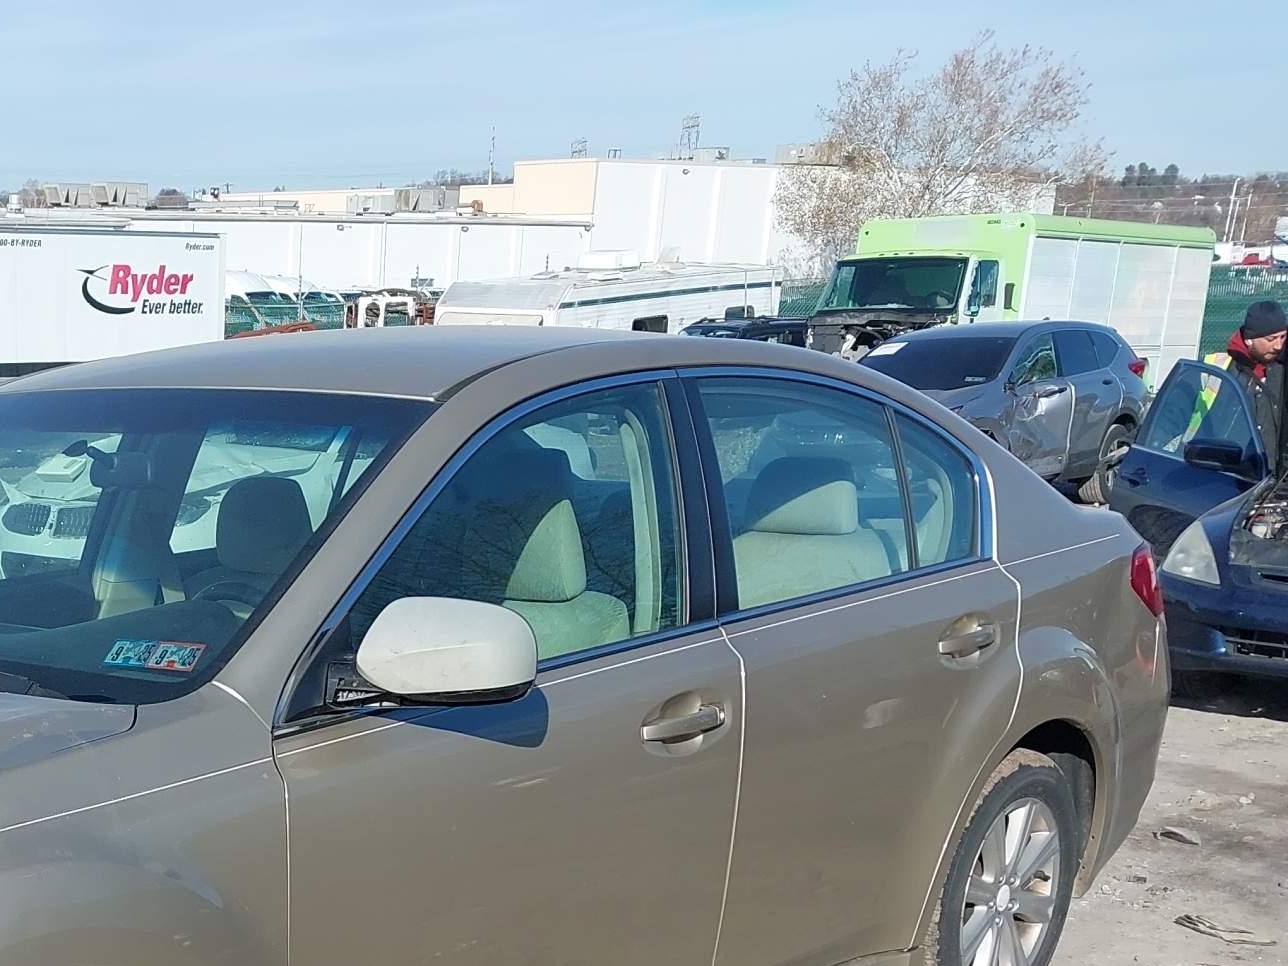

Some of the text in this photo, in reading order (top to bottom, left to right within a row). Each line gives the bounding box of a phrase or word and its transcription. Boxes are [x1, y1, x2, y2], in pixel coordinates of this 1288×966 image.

[185, 242, 215, 252] Ryder.com
[108, 264, 194, 302] Ryder
[141, 299, 204, 315] Ever better.
[111, 646, 125, 662] 9
[155, 649, 169, 666] 9
